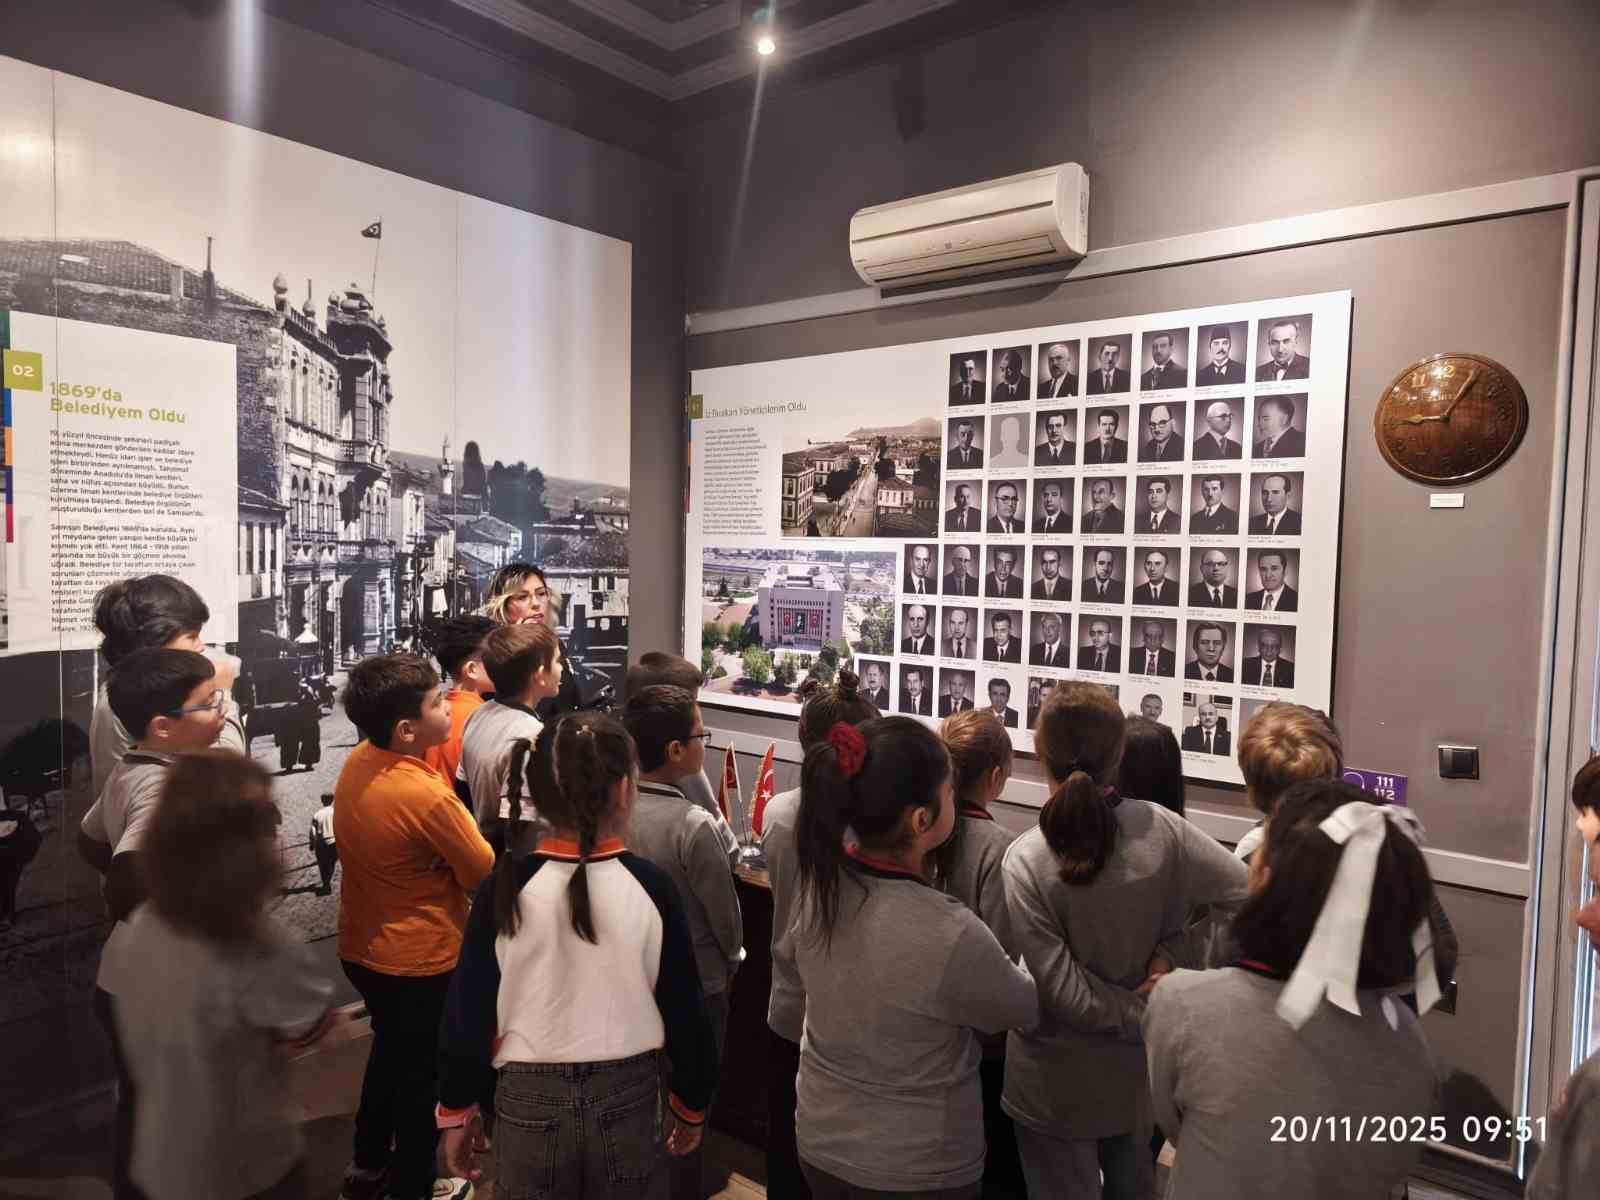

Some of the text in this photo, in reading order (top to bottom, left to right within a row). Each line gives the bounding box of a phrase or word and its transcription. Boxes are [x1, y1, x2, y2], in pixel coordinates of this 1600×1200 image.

[12, 365, 34, 377] 02
[50, 382, 123, 402] 1869'da
[50, 398, 186, 424] Belediyem Oldu
[787, 400, 807, 412] Oldu
[1376, 775, 1394, 787] 111
[1374, 788, 1395, 801] 112
